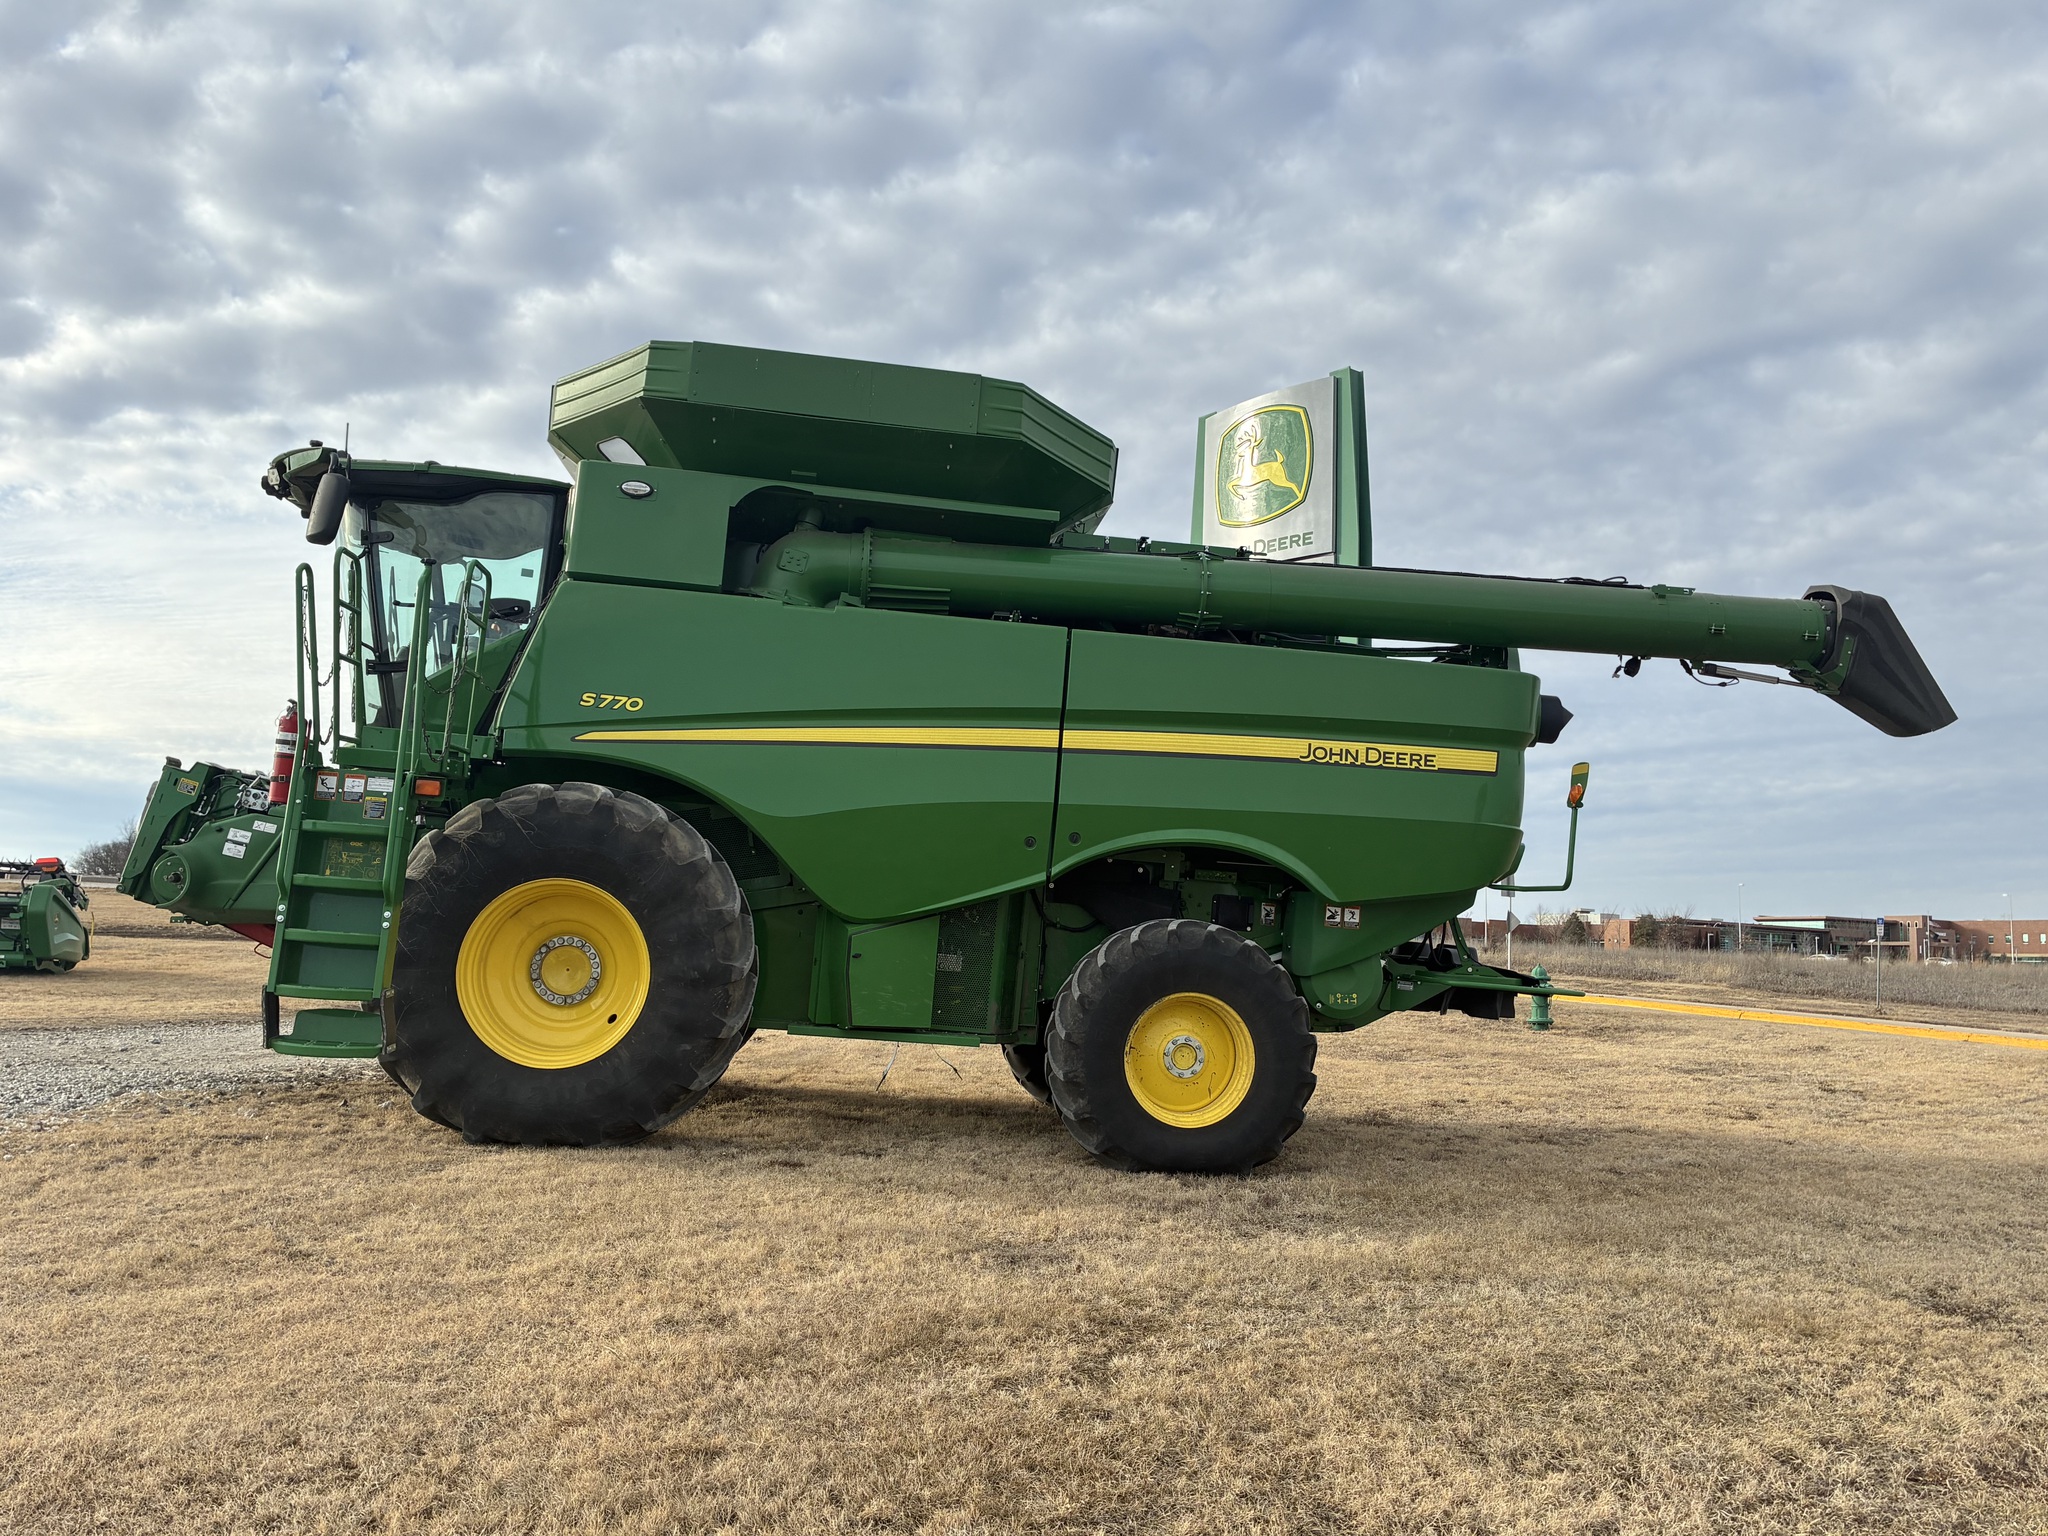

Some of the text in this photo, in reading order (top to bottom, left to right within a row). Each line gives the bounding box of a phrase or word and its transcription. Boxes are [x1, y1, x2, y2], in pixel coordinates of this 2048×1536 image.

[1253, 531, 1314, 556] DEERE
[579, 692, 644, 712] S770
[1299, 743, 1437, 768] JOHN DEERE
